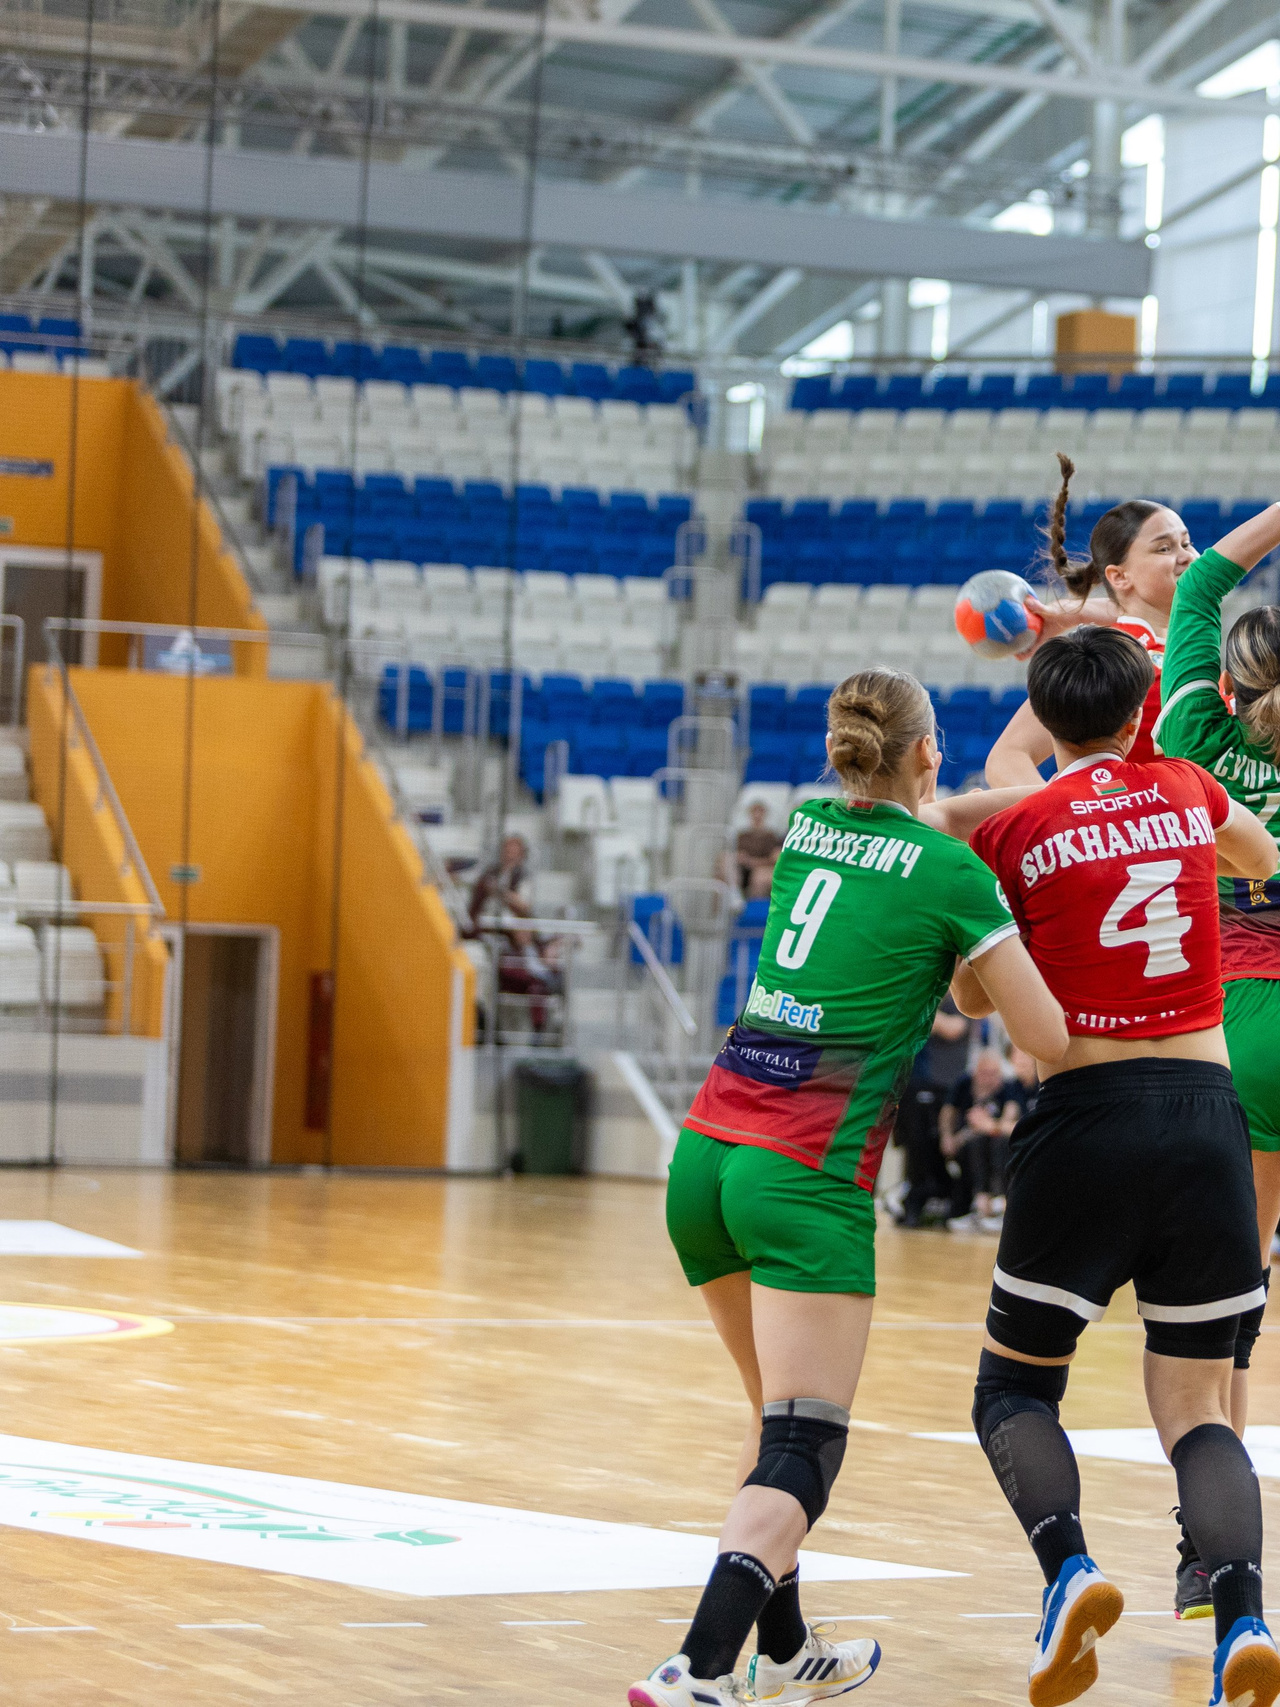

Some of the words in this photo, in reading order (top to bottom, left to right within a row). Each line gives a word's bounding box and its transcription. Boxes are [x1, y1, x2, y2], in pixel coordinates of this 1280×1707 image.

[1070, 783, 1168, 815] SPORTIX
[1020, 806, 1216, 888] SUKHAMIRAV
[776, 868, 842, 969] 9
[1099, 859, 1193, 978] 4
[749, 986, 823, 1032] BelFert
